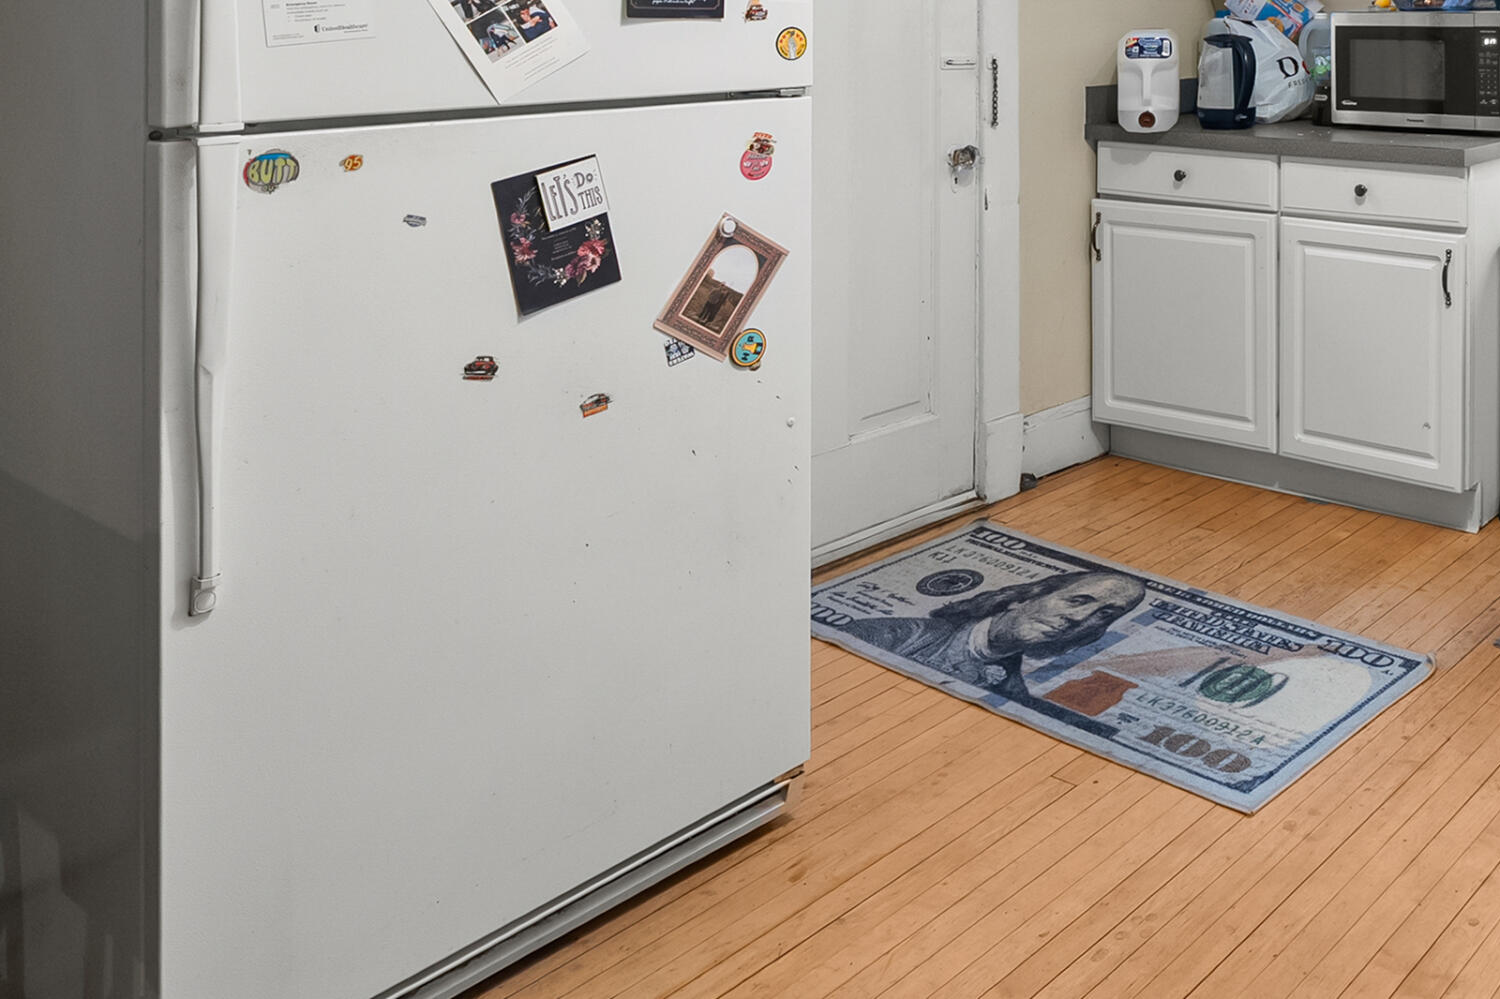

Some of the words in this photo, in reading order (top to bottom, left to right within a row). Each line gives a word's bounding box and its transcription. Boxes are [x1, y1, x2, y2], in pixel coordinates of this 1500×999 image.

[248, 157, 297, 185] BUTT
[344, 156, 362, 171] 95
[541, 173, 580, 222] LET'S
[578, 186, 604, 211] THIS
[968, 526, 1028, 551] 100
[811, 601, 854, 627] 00
[1317, 637, 1397, 669] 100
[1137, 723, 1253, 774] 100
